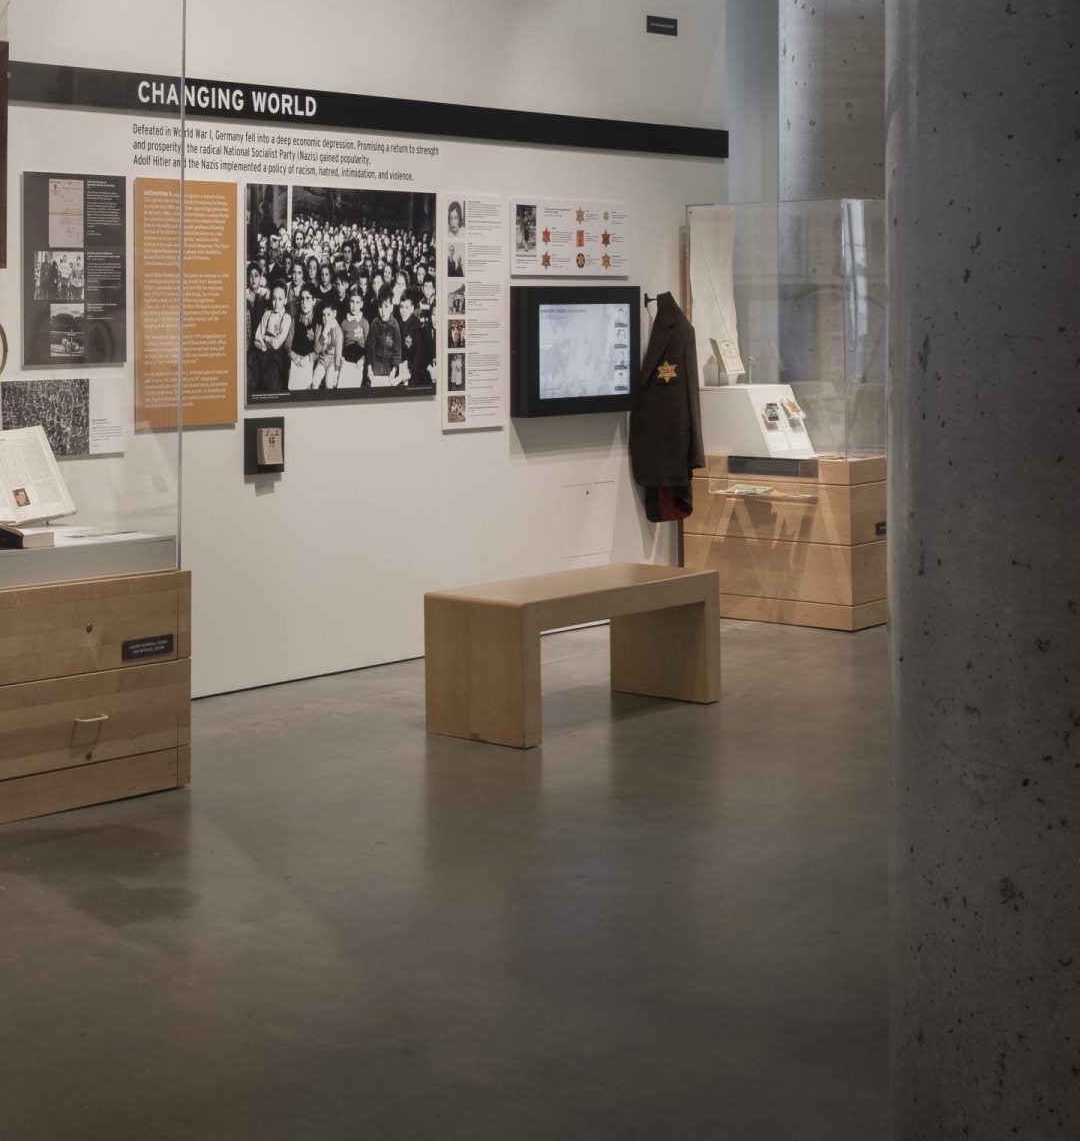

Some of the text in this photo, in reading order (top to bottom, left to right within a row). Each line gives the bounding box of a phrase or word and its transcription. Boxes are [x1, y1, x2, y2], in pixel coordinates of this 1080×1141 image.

[137, 81, 317, 118] CHANGING WORLD
[133, 123, 164, 137] Defeated
[165, 125, 171, 137] in
[195, 128, 207, 139] War
[215, 129, 243, 144] Germany
[246, 131, 255, 143] fell
[257, 132, 270, 144] into
[271, 135, 276, 143] a
[276, 134, 291, 147] deep
[292, 136, 321, 148] economic
[322, 138, 356, 150] depression.
[357, 140, 385, 153] Promising
[386, 144, 390, 152] a
[391, 144, 408, 153] return
[409, 145, 415, 153] to
[416, 146, 439, 157] strength
[133, 140, 145, 150] and
[187, 143, 198, 154] the
[199, 144, 222, 155] radical
[223, 145, 250, 158] National
[251, 147, 278, 159] Socialist
[279, 149, 296, 161] Party
[297, 150, 318, 162] (Nazis)
[319, 152, 339, 164] gained
[340, 153, 371, 166] popularity.
[133, 154, 414, 181] Adolf Hitler and the Nazis implemented a policy of racism, hatred, intimidation, and violence.
